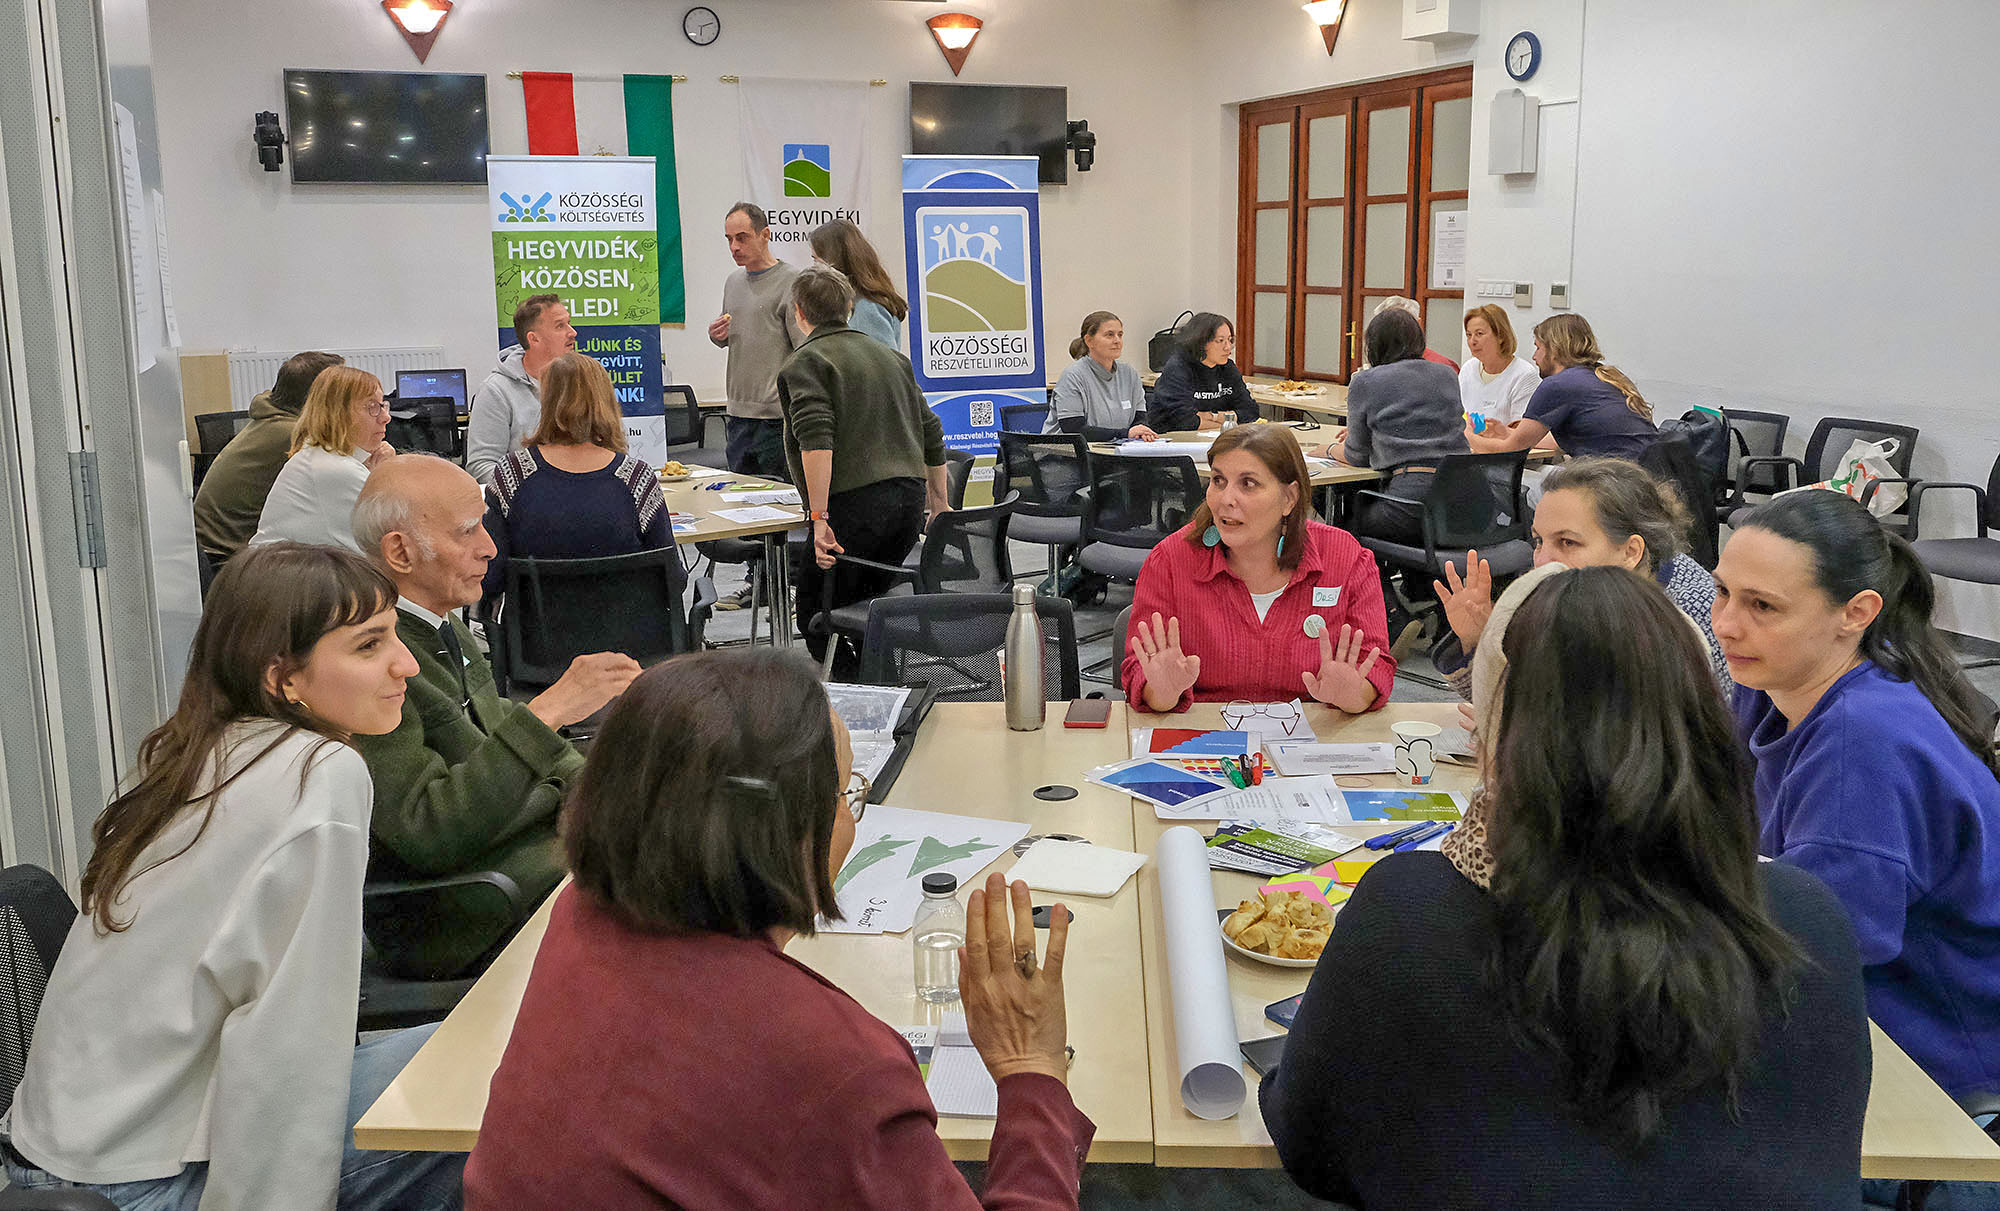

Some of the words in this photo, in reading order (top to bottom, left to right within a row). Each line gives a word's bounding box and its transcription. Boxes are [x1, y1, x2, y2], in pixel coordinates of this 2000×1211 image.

[559, 192, 643, 208] KÖZÖSSÉGI
[559, 208, 645, 223] KÖLTSÉGVETÉS
[763, 207, 860, 225] EGYVIDÉKI
[507, 236, 644, 262] HEGYVIDÉK,
[520, 266, 635, 291] KÖZÖSEN,
[561, 297, 619, 317] LED!
[624, 336, 642, 351] ÉS
[930, 334, 1027, 356] KÖZÖSSÉGI
[595, 354, 643, 369] GYÜTT,
[930, 358, 992, 371] RÉSZVÉTELI
[994, 357, 1029, 369] IRODA
